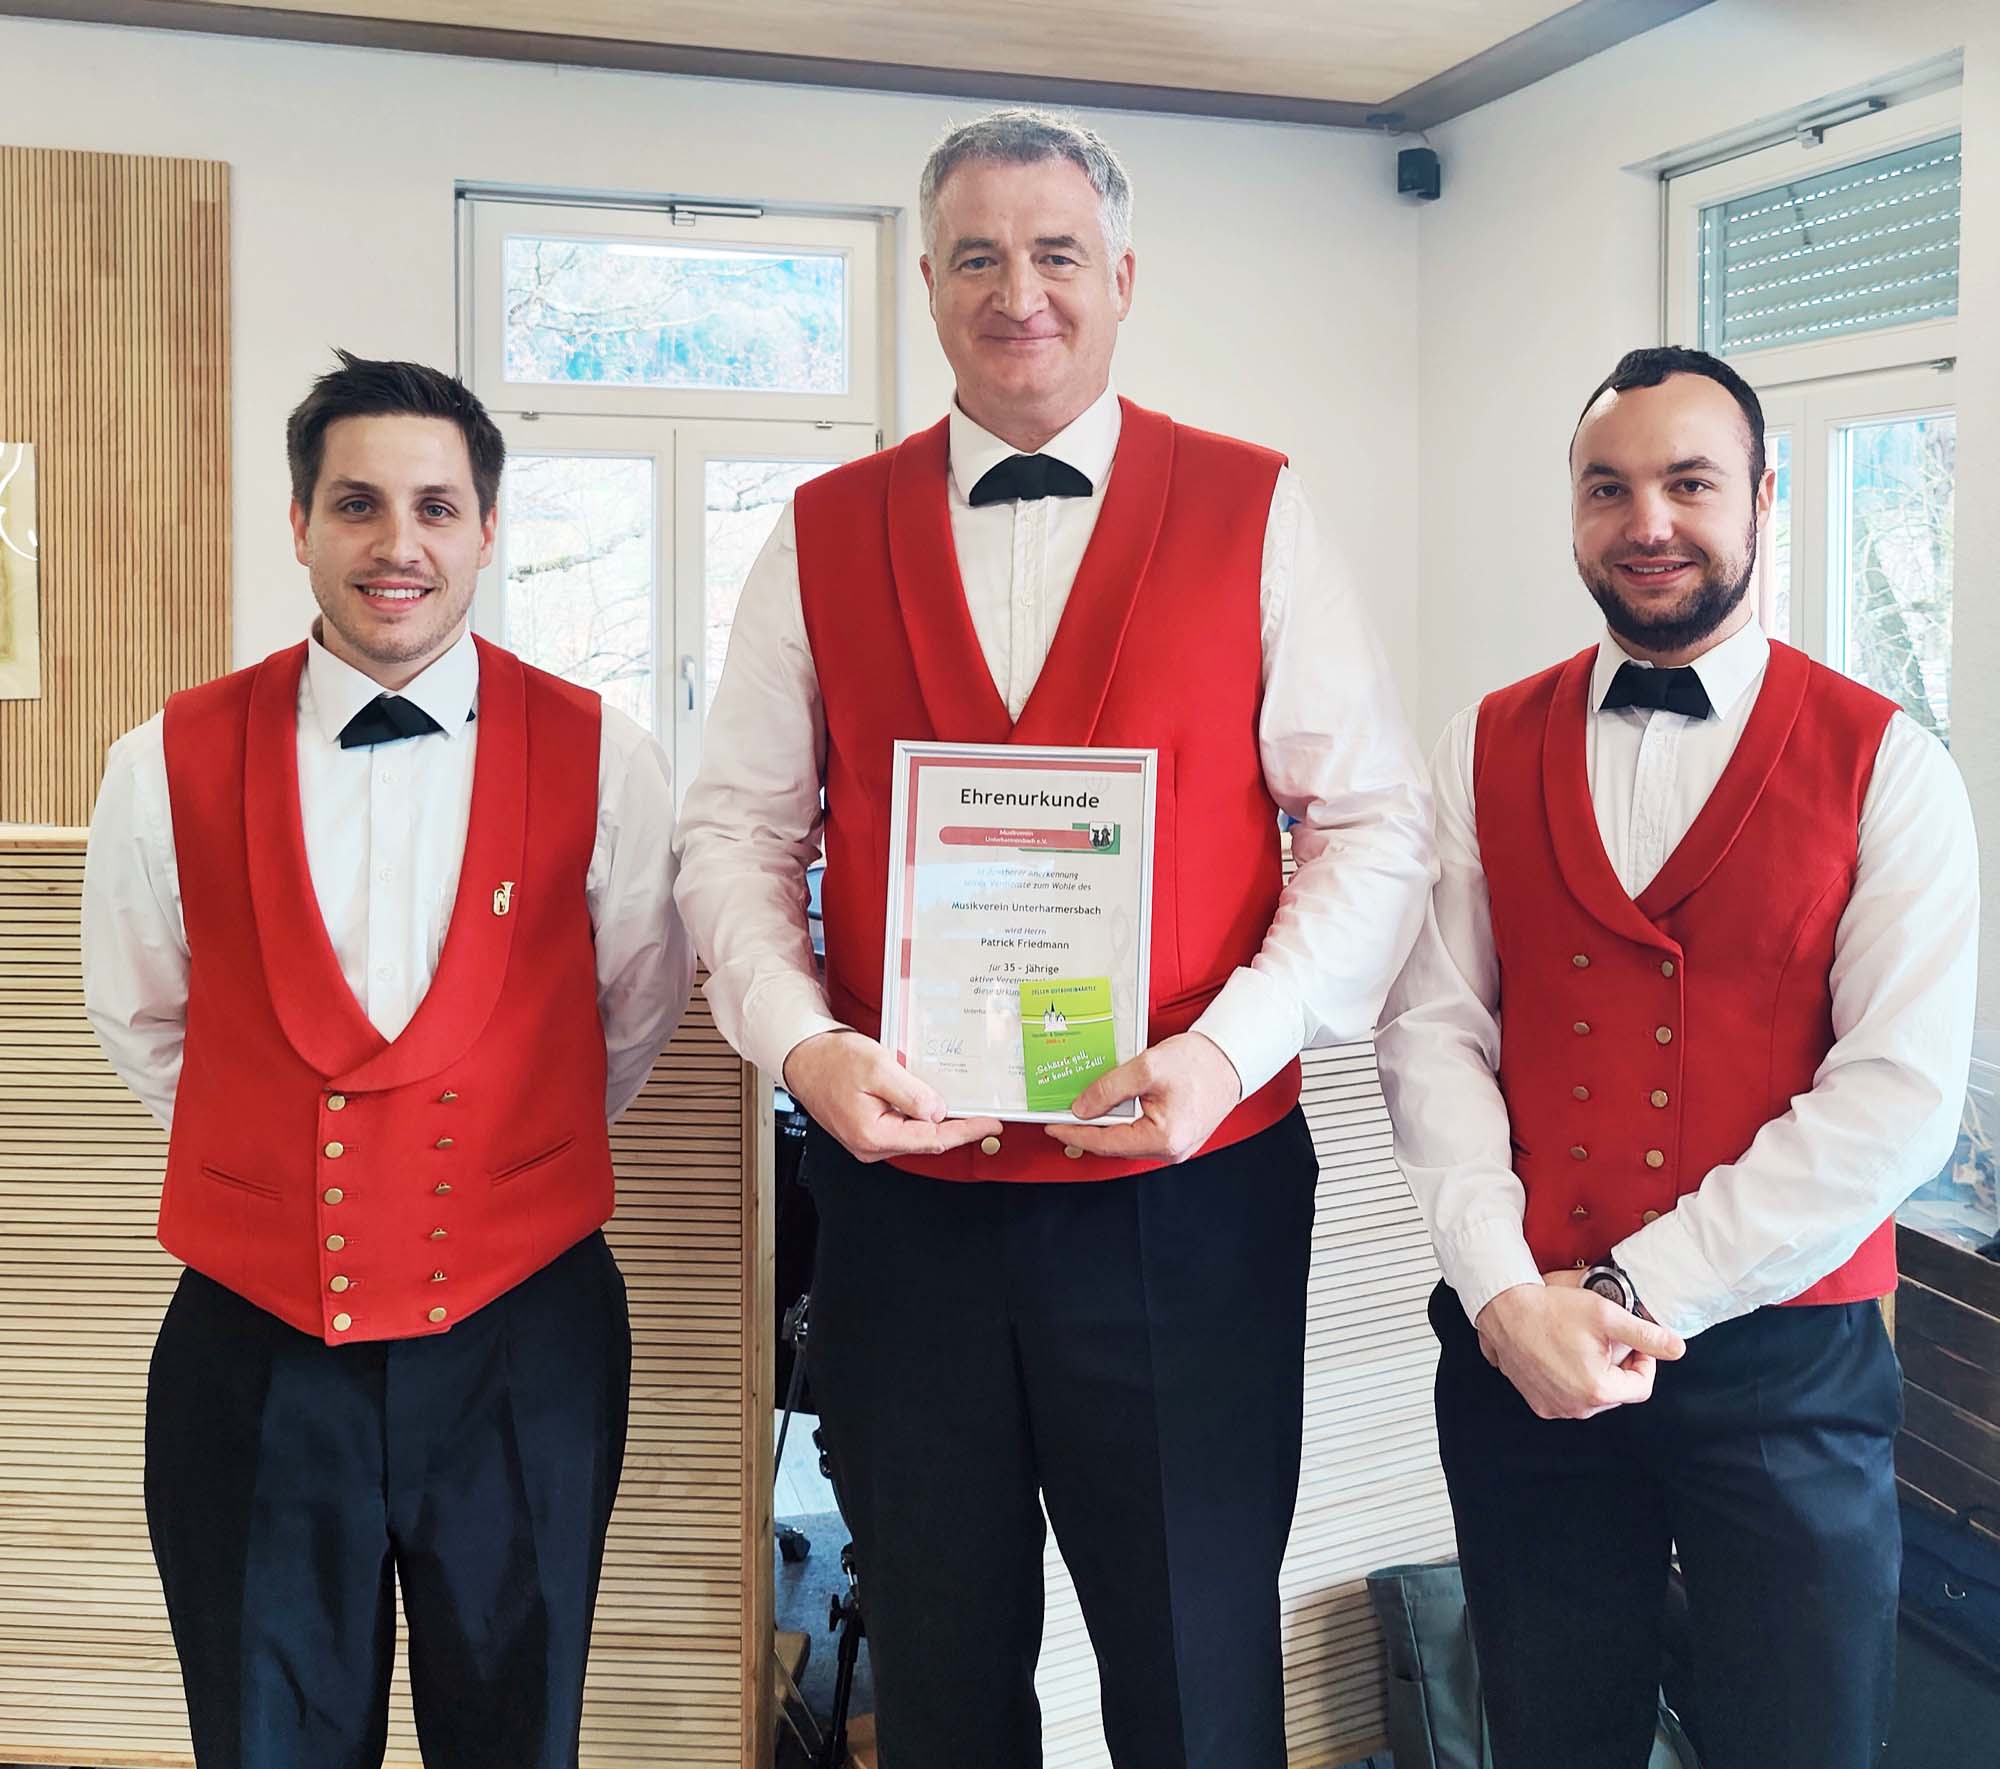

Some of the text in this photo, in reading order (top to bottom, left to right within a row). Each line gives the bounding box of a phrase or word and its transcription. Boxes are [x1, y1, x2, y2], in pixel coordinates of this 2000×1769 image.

[961, 788, 1100, 808] Ehrenurkunde
[1052, 881, 1076, 890] Wohle
[1077, 882, 1092, 891] des
[951, 901, 1101, 915] Musikverein Unterharmersbach
[1004, 926, 1047, 936] wird Herrn
[980, 938, 1070, 950] Patrick Friedmann
[1004, 963, 1016, 972] 35
[970, 975, 994, 983] aktive
